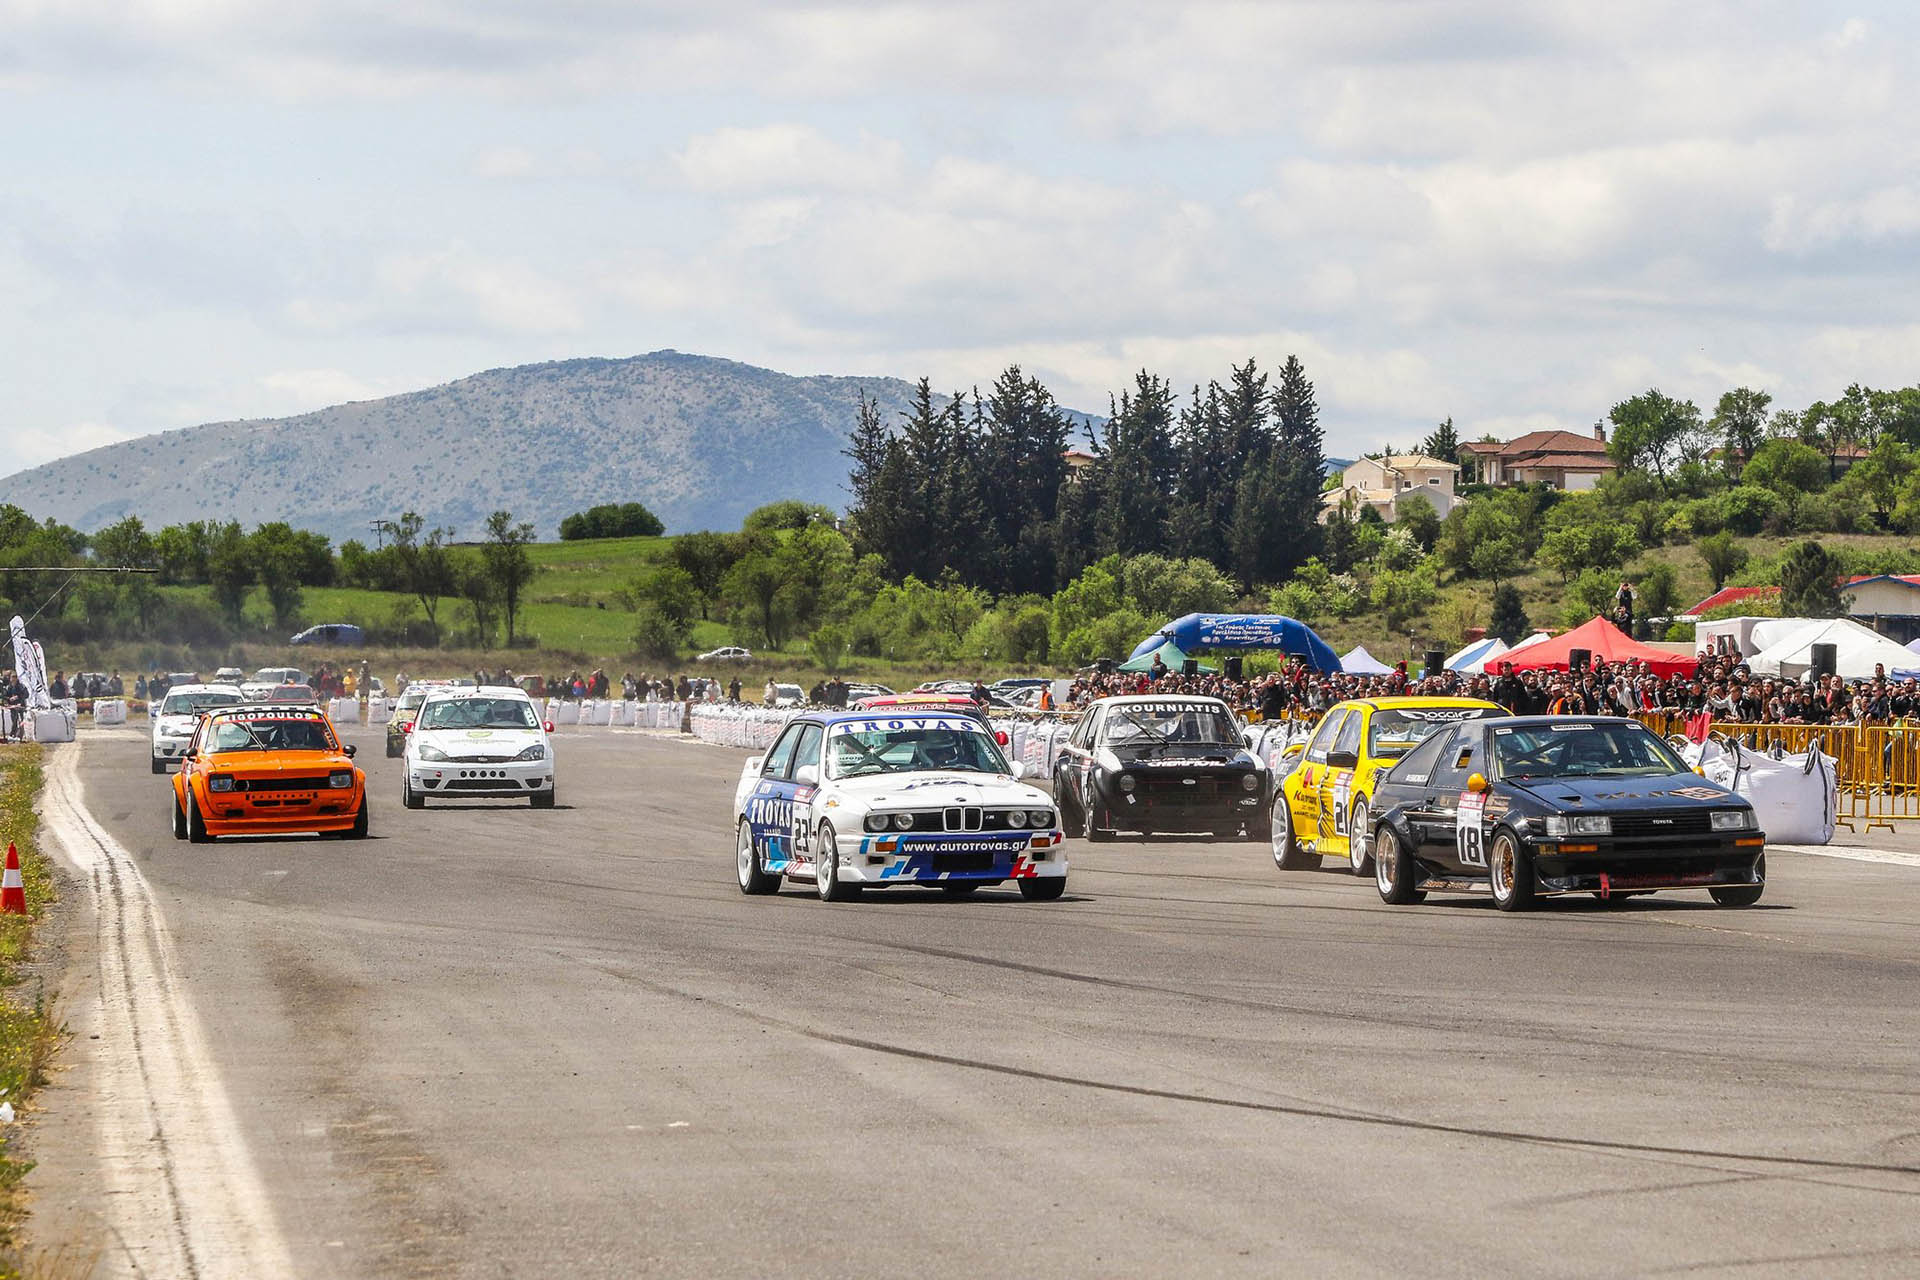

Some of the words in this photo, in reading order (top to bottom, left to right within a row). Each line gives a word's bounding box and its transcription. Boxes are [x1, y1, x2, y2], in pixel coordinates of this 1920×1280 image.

[223, 712, 313, 722] RIGOPOULOS
[1121, 704, 1220, 714] KOURNIATIS
[838, 720, 974, 734] TROVAS
[750, 799, 791, 828] TROVAS
[1335, 801, 1348, 834] 21
[795, 818, 809, 853] 23
[1458, 826, 1480, 863] 18
